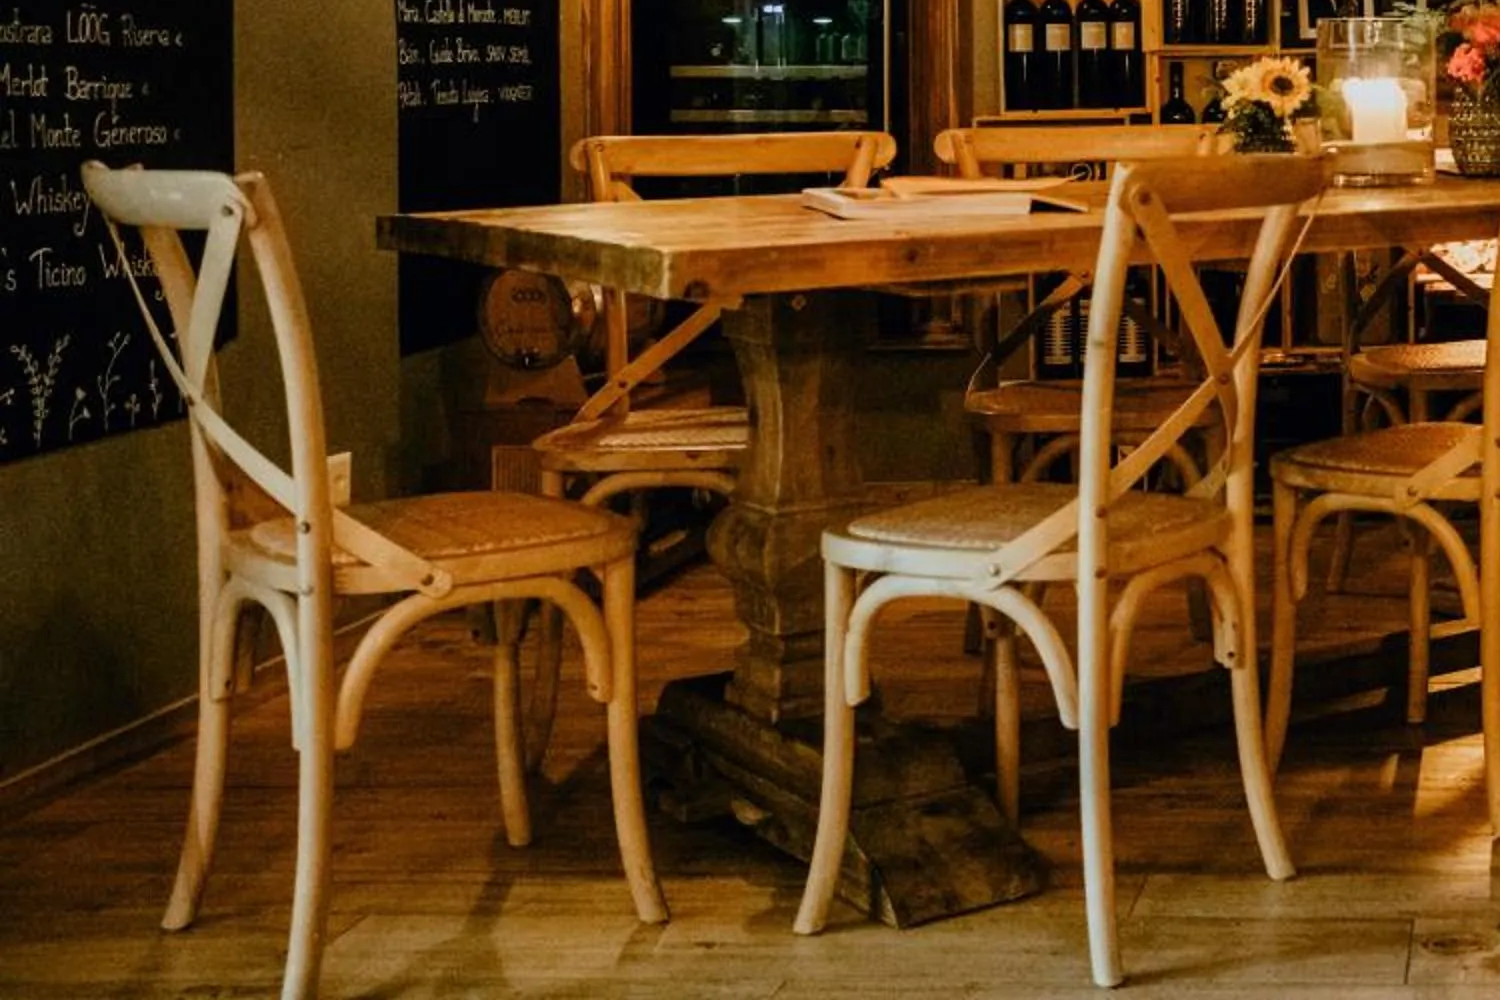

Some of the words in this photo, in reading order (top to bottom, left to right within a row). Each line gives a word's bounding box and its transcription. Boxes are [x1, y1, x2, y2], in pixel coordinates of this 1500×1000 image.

[64, 65, 134, 125] Barrique
[30, 112, 81, 149] Monte
[93, 110, 168, 148] Generoso
[10, 172, 91, 237] Whiskey
[28, 247, 87, 290] Ticino
